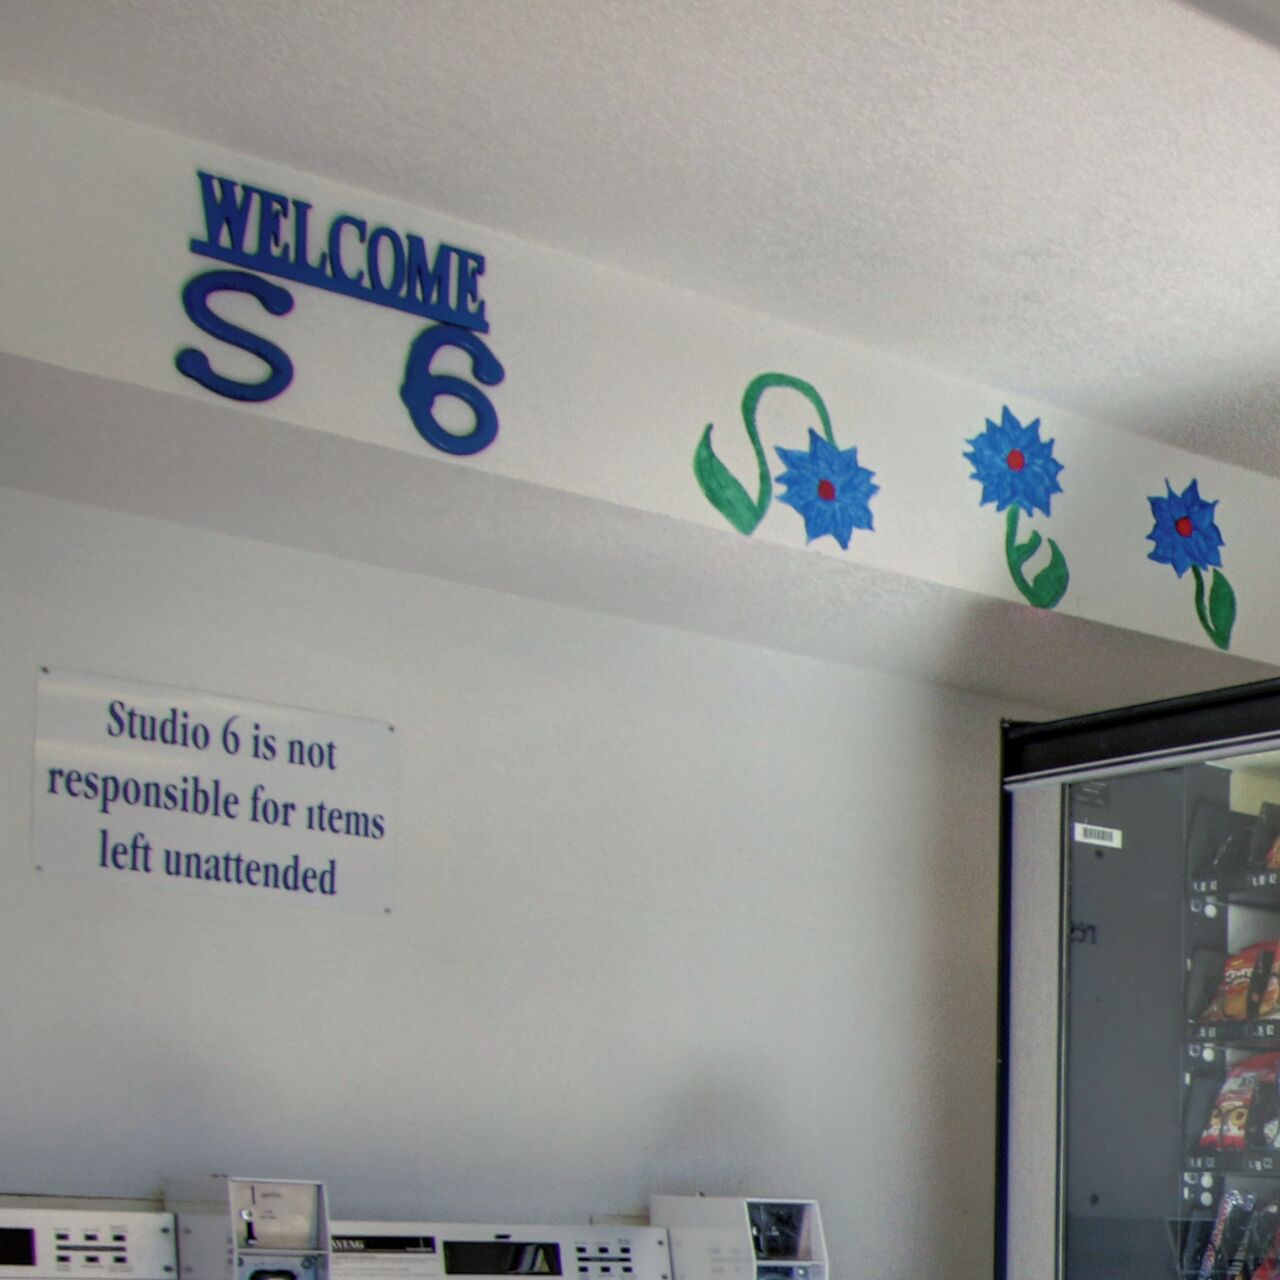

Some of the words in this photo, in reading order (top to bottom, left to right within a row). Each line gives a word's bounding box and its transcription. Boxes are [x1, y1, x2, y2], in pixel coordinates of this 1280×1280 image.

[196, 170, 490, 328] WELCOME
[174, 267, 295, 405] S
[400, 322, 506, 457] 6
[106, 701, 211, 752] Studio
[220, 715, 242, 757] 6
[251, 722, 277, 760] is
[287, 731, 339, 771] not
[46, 766, 240, 822] responsible
[250, 787, 297, 828] for
[305, 797, 387, 841] items
[98, 829, 154, 875] left
[162, 845, 338, 897] unattended
